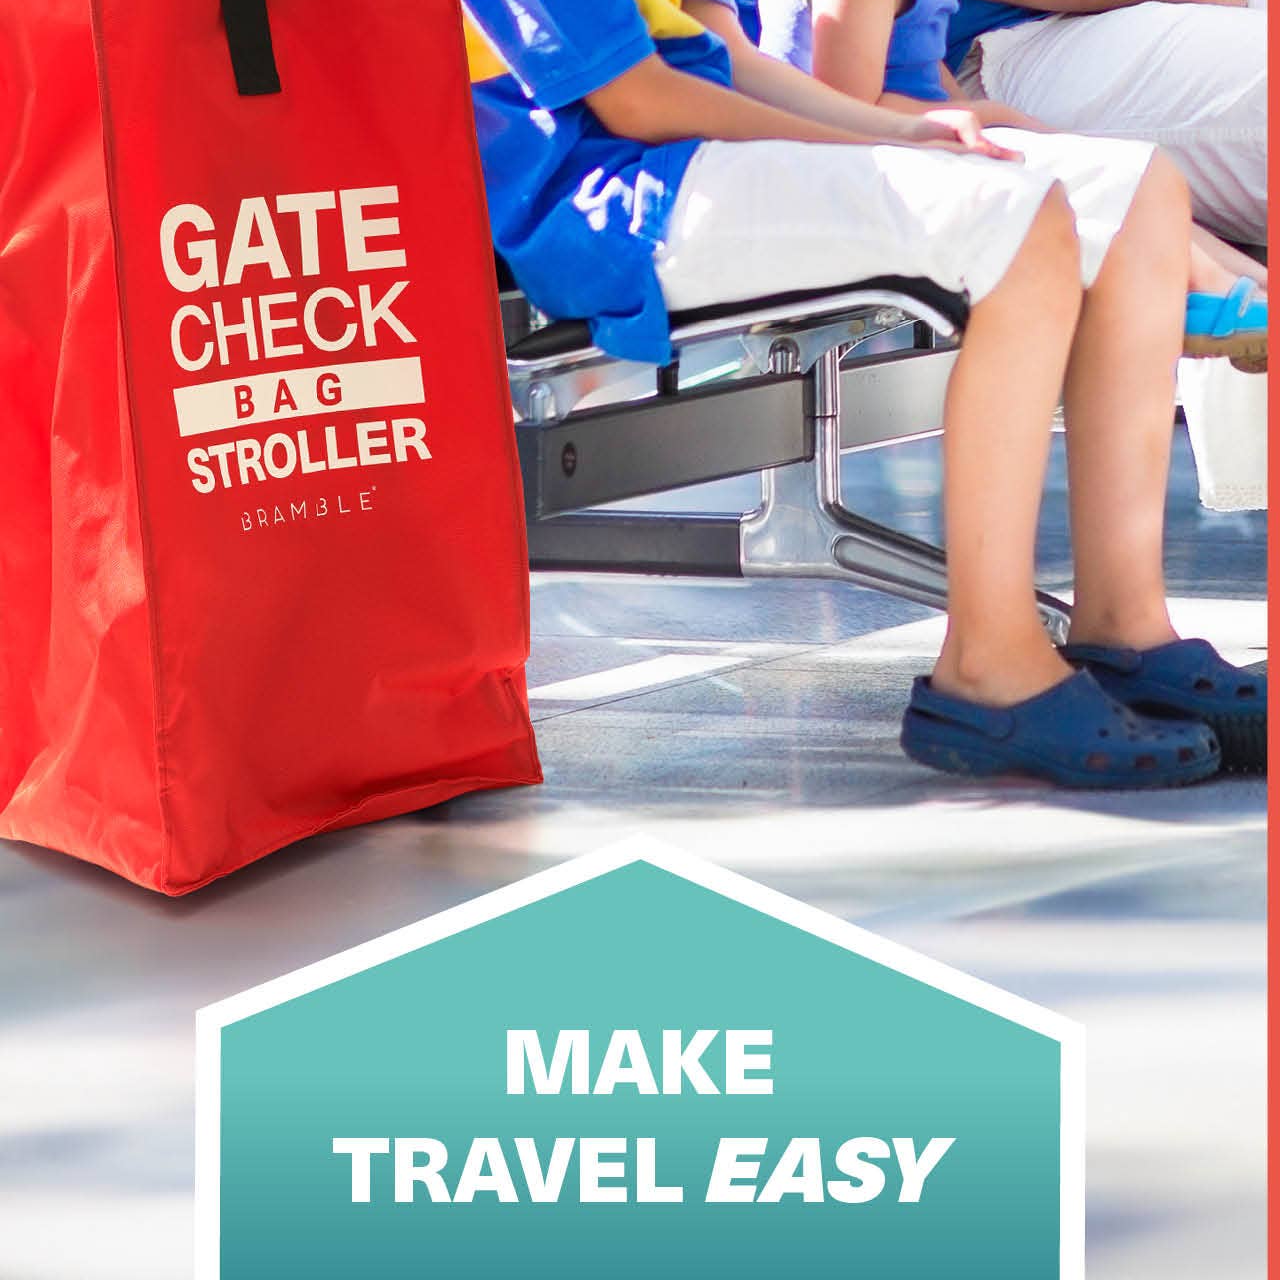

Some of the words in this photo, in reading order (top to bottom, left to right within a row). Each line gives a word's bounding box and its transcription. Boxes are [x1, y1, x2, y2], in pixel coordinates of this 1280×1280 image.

[160, 185, 408, 293] GATE
[170, 280, 418, 372] CHECK
[233, 372, 343, 420] BAG
[186, 417, 433, 494] STROLLER
[241, 489, 375, 532] BRAMBLE
